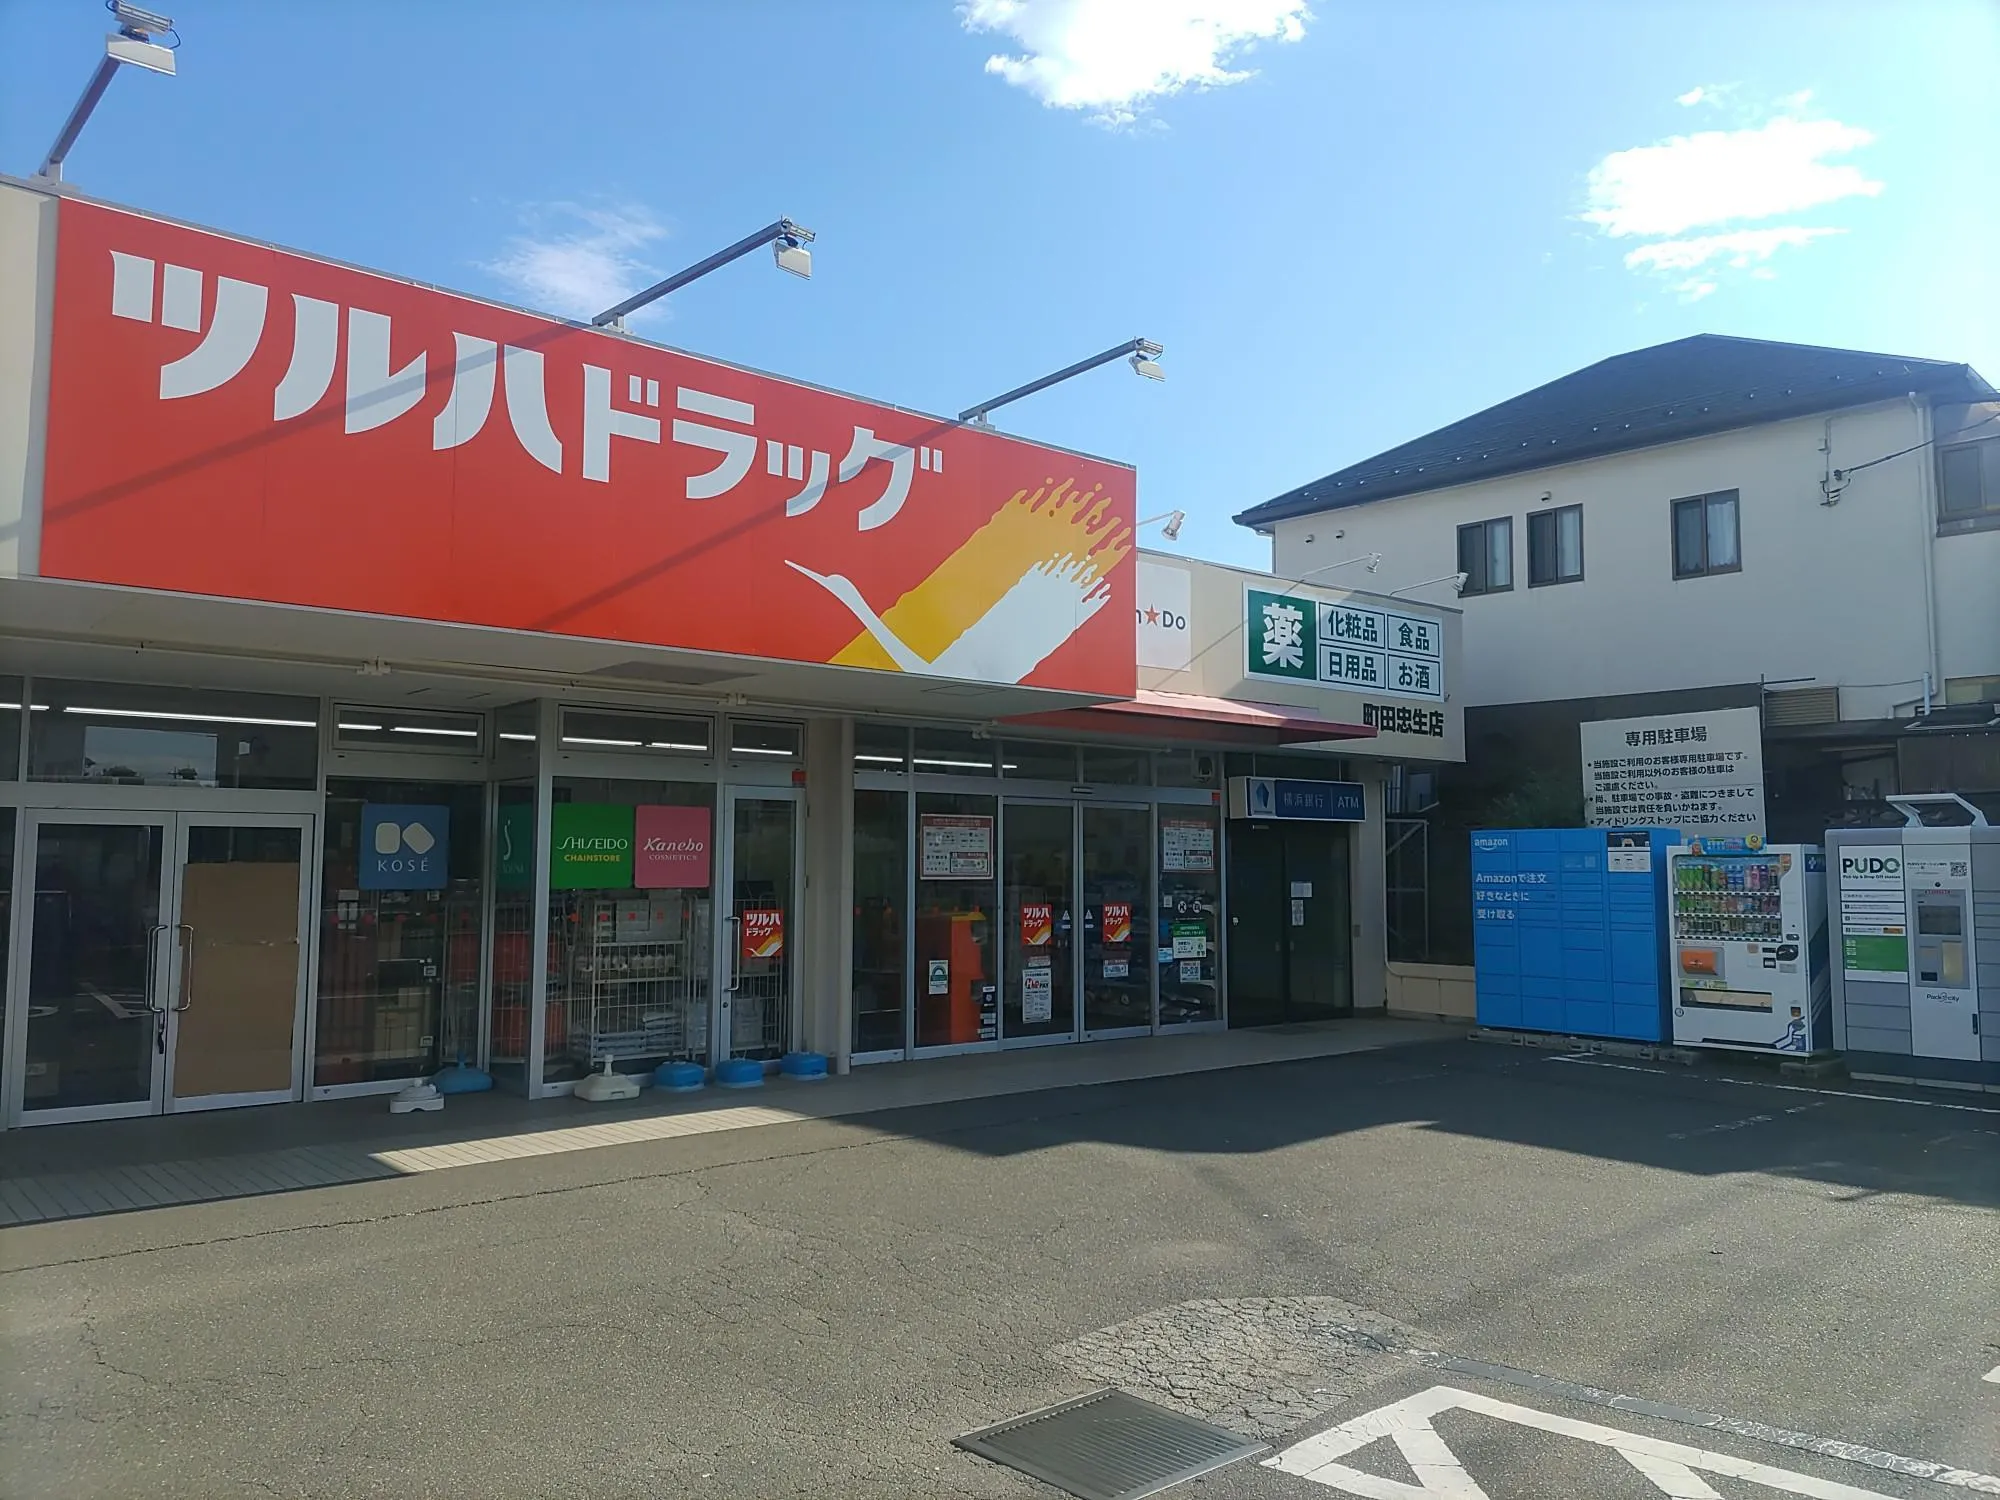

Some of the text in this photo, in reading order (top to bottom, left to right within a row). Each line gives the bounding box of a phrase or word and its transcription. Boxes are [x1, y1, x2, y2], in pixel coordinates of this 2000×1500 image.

[110, 250, 944, 531] ツルハドラッグ
[1328, 609, 1378, 643] 化粧品
[1262, 602, 1304, 669] 薬
[1398, 622, 1430, 651] 食品
[1328, 651, 1377, 682] 日用品
[1398, 661, 1430, 690] お酒
[1363, 702, 1444, 738] 町田忠生店
[1624, 726, 1708, 747] 専用駐車場
[1594, 764, 1735, 780] 当施設ご利用以外のお客様の駐車は
[1337, 796, 1360, 809] ATM
[556, 836, 628, 850] SHISEIDO
[643, 837, 704, 852] Kanebo
[1474, 837, 1508, 848] amazon
[377, 857, 429, 873] KOSÉ
[564, 853, 621, 862] CHAINSTORE
[1842, 857, 1901, 874] PUDO
[1475, 872, 1548, 884] Amazonで注文
[1476, 891, 1530, 902] 好きなときに
[1023, 907, 1050, 919] ツルハ
[1104, 905, 1129, 917] ツルハ
[1477, 909, 1515, 920] 受け取る
[745, 912, 781, 927] ツルハ
